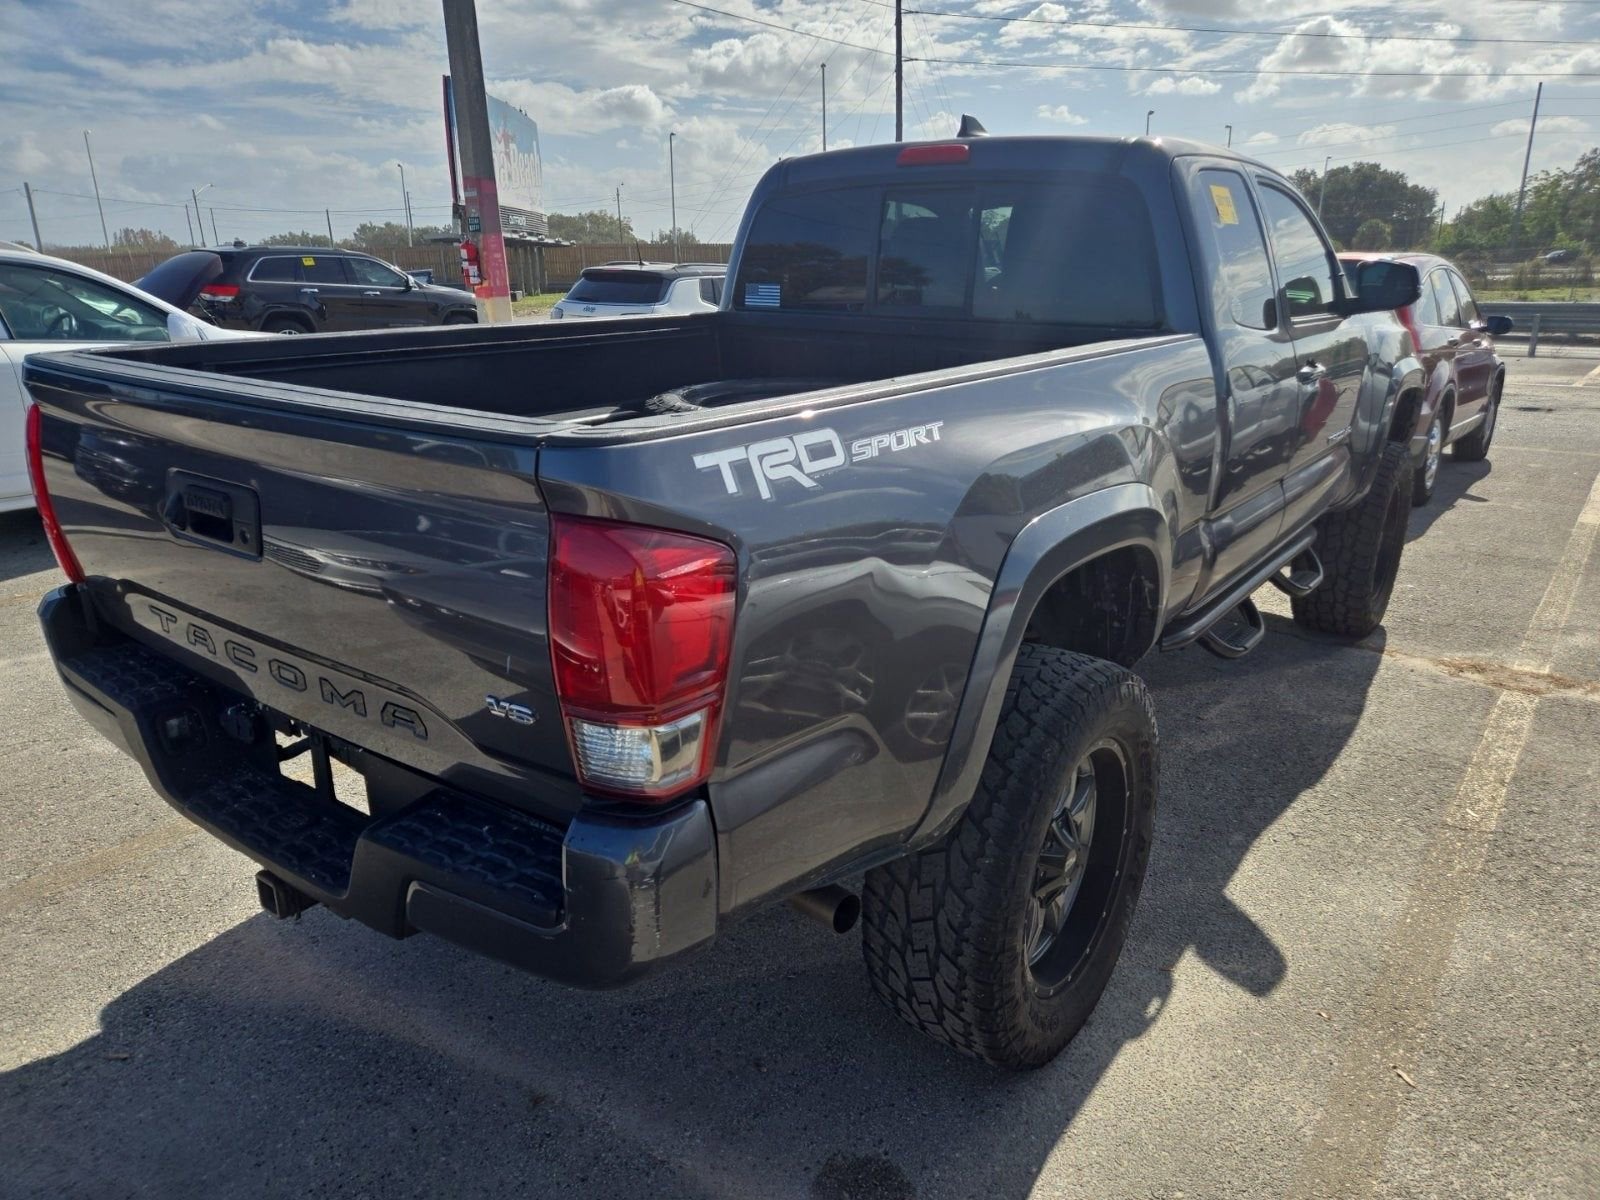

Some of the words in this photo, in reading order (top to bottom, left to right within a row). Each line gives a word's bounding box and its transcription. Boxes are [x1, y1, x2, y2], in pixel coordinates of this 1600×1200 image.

[693, 427, 846, 500] TRD
[851, 421, 944, 463] SPORT
[149, 605, 429, 740] TACOMA
[485, 694, 540, 726] V6
